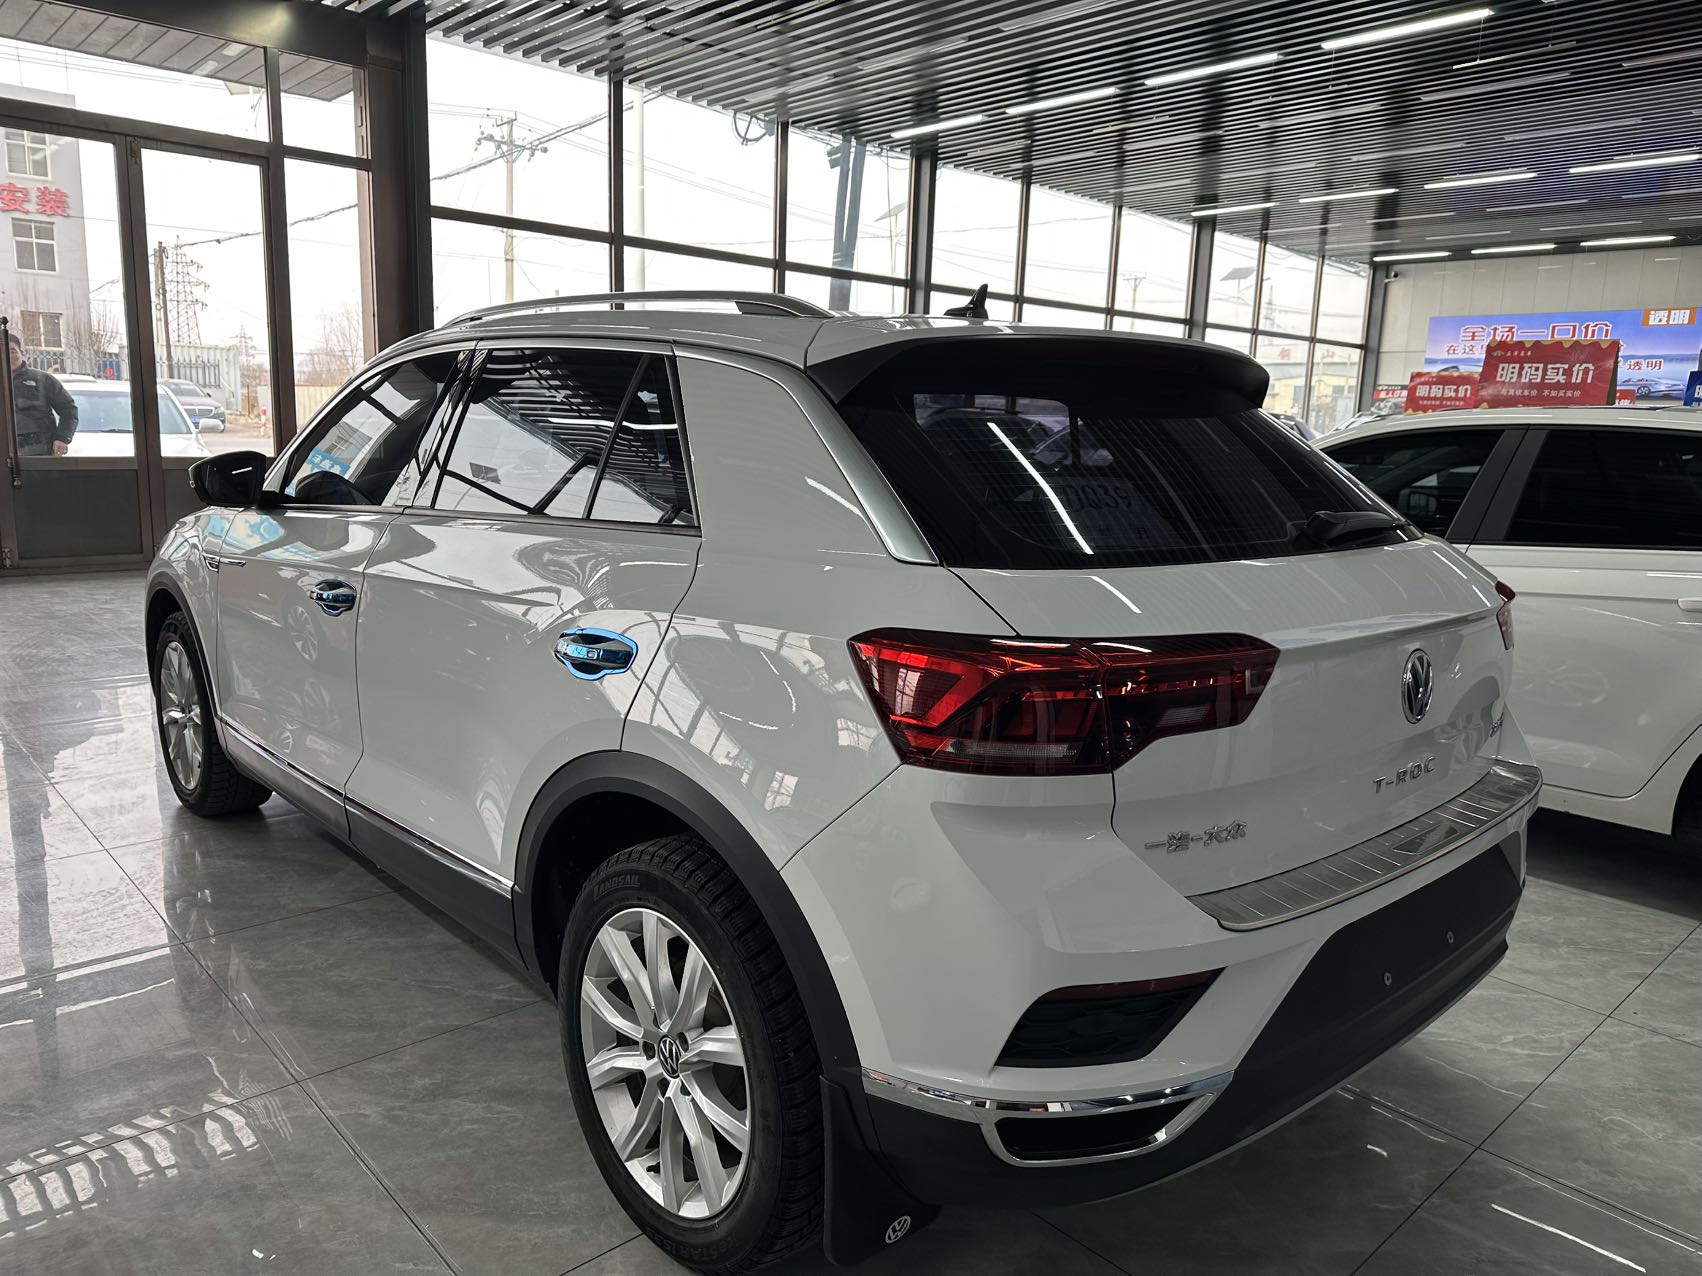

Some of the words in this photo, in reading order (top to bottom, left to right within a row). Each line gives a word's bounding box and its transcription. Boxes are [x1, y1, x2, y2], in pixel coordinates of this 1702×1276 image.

[0, 182, 70, 217] 安装
[1460, 321, 1613, 342] 全场一口价
[1495, 363, 1595, 384] 明码实价
[1618, 358, 1664, 371] 透明
[1373, 756, 1436, 794] T-ROC
